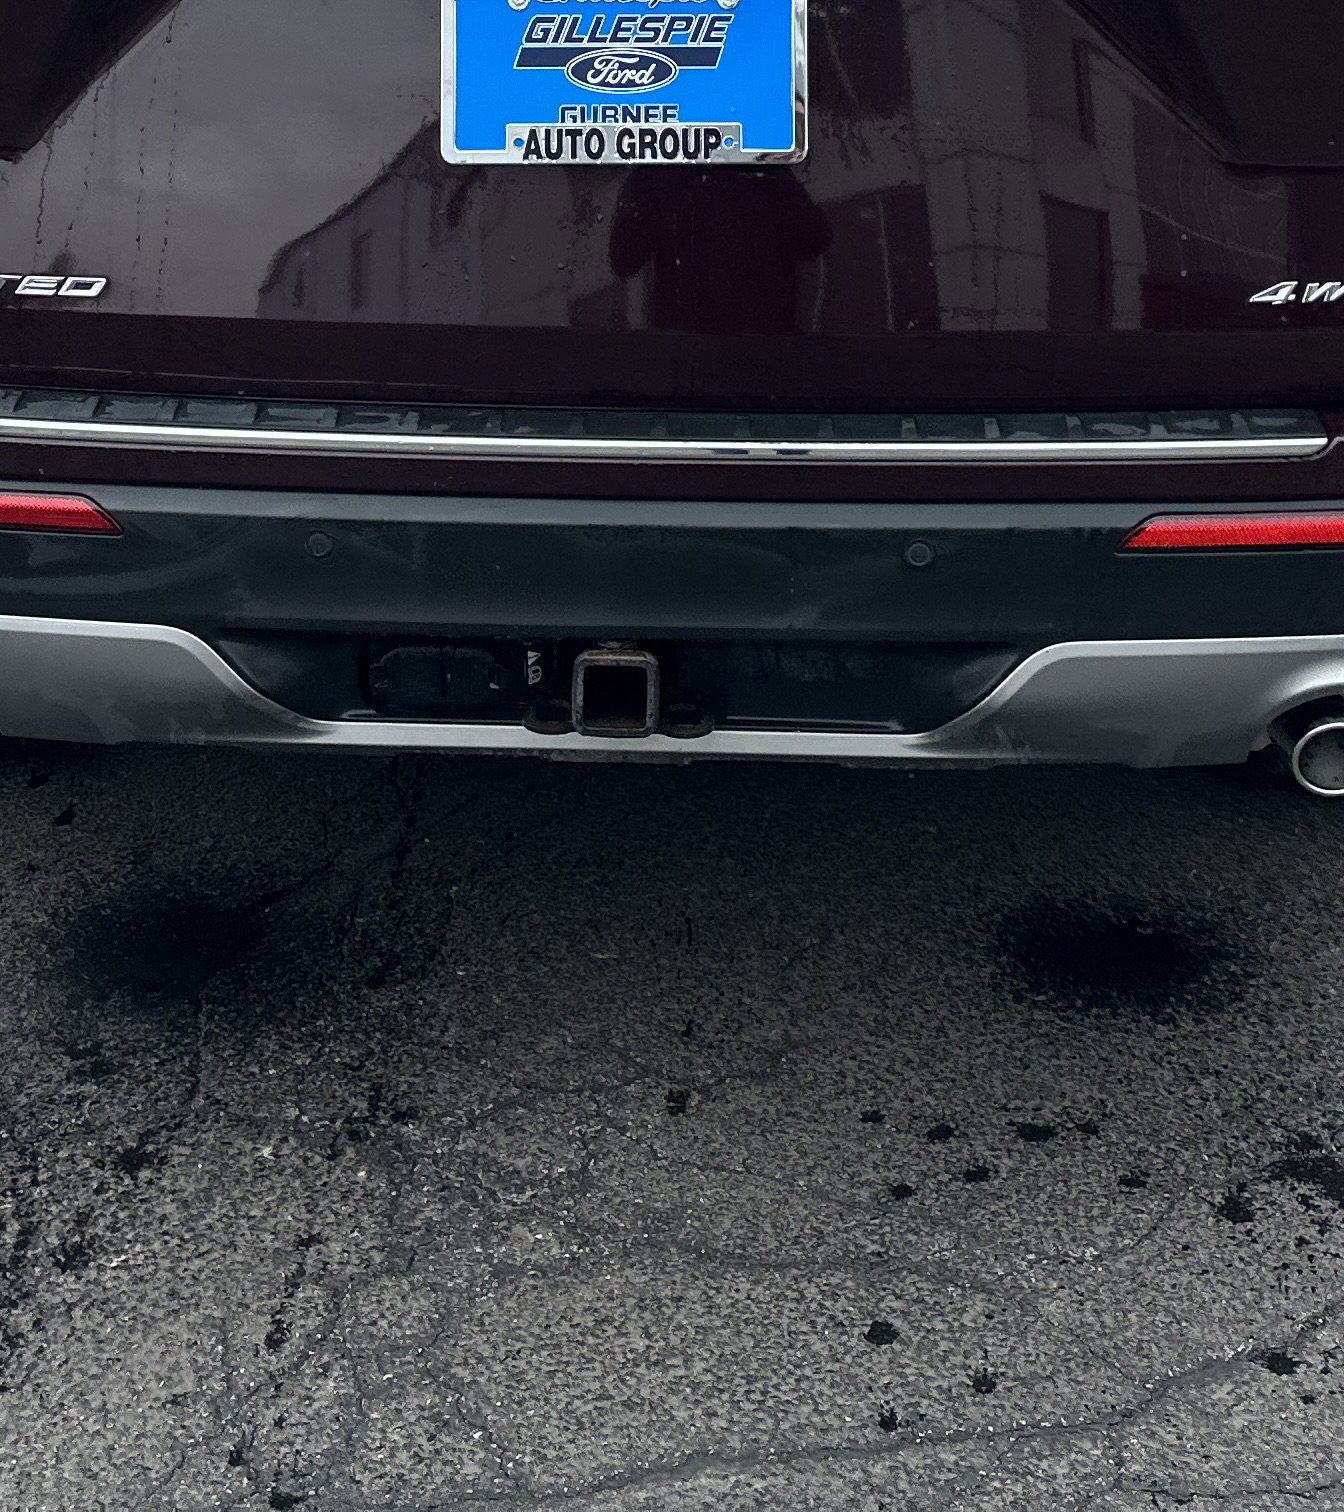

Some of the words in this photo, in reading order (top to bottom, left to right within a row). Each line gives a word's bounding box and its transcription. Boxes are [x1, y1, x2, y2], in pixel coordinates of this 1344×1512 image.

[523, 15, 733, 44] GILLESPIE
[586, 55, 657, 85] Ford
[522, 127, 606, 161] AUTO
[615, 127, 722, 161] GROUP
